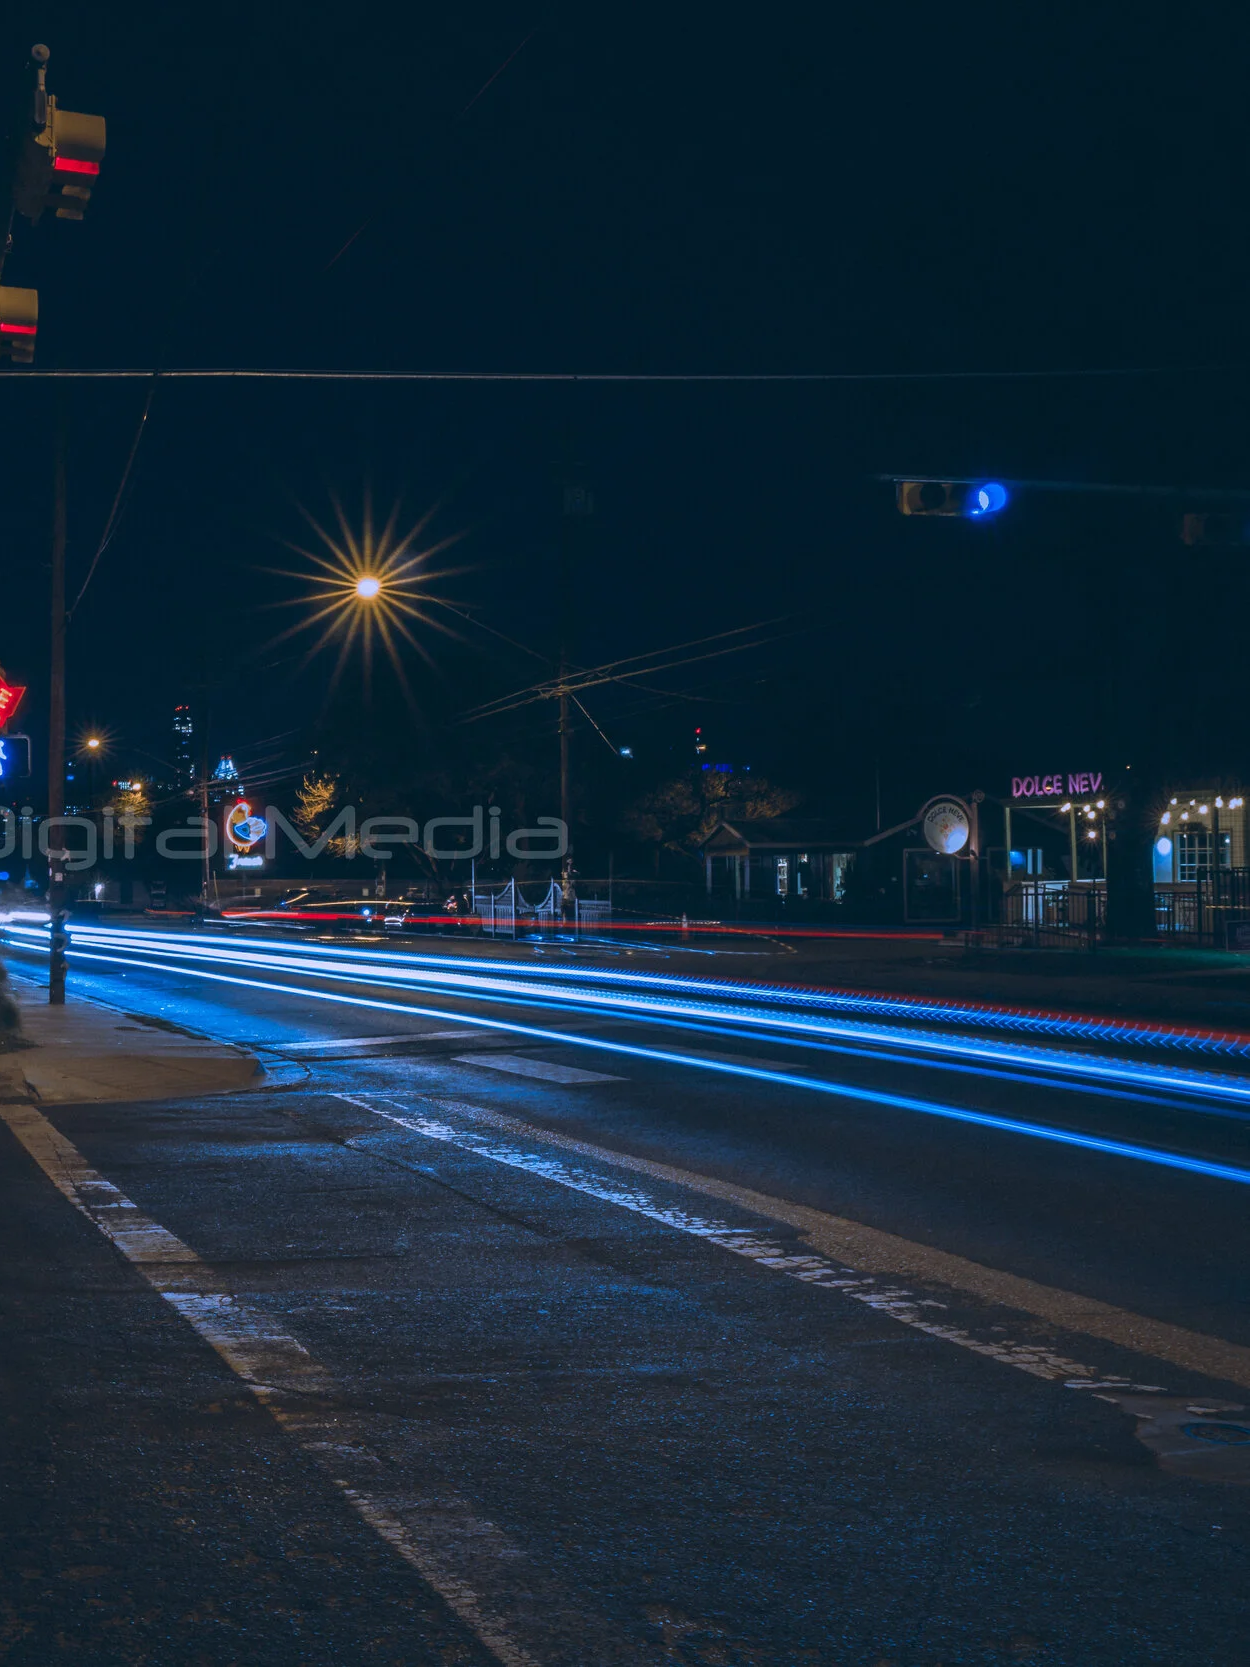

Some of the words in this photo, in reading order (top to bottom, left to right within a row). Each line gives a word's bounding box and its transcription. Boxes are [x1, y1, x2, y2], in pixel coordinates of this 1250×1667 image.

[1011, 774, 1063, 798] DOLCE
[1068, 772, 1104, 795] NEV
[927, 806, 948, 823] DOLCE
